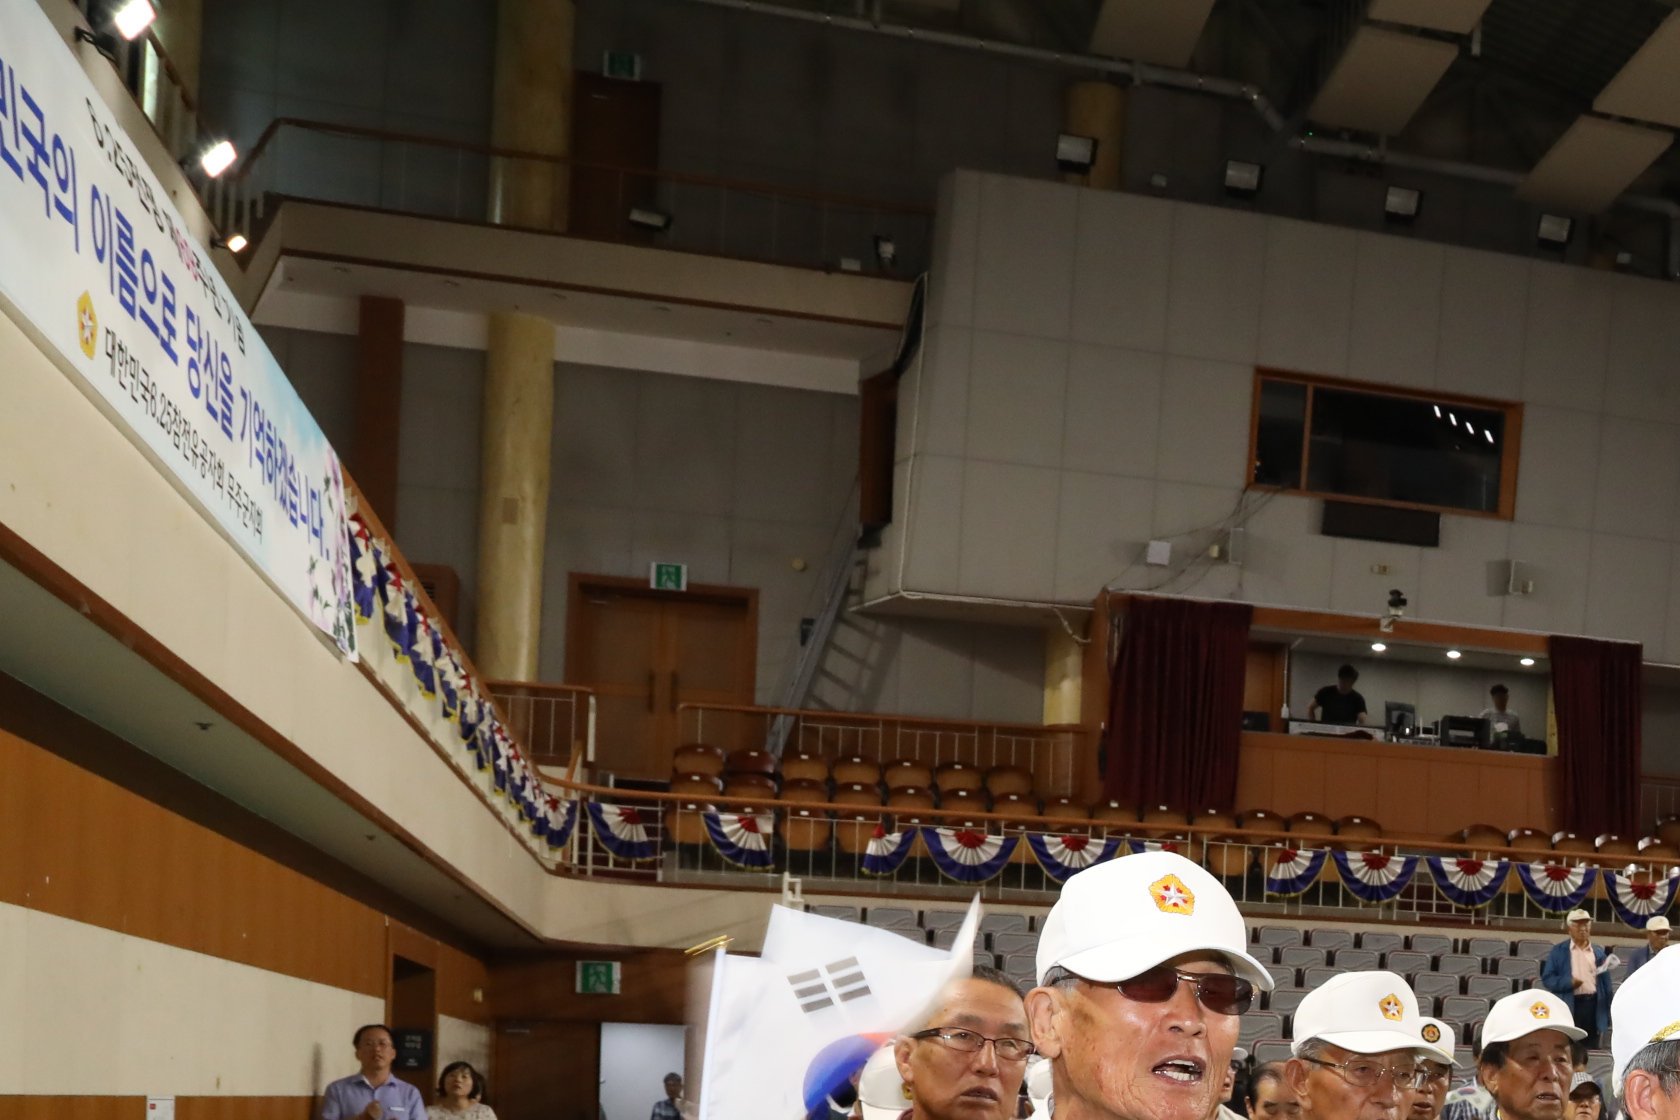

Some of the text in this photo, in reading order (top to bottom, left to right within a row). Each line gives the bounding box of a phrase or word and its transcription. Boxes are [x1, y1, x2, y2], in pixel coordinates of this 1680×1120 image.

[90, 183, 179, 367] 이름으로
[185, 303, 235, 443] 당신을
[240, 385, 330, 562] 기억하겠습니다.
